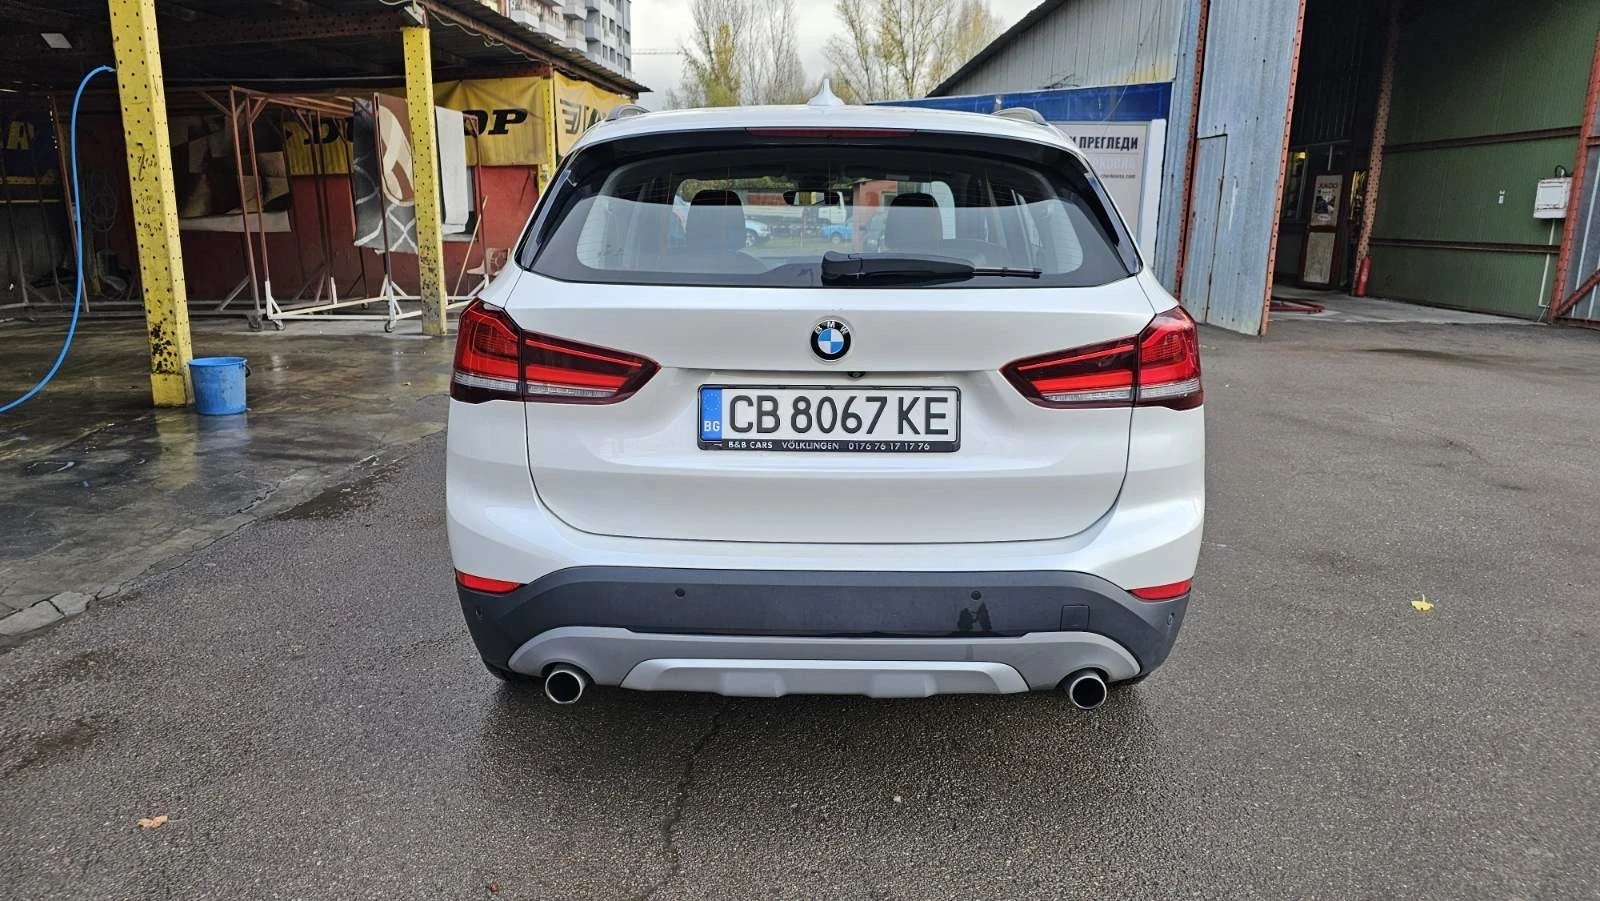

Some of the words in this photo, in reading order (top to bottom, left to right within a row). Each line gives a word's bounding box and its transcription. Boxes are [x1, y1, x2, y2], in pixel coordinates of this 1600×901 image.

[1079, 136, 1139, 151] ПРЕГЛЕДИ
[814, 320, 849, 335] BMW
[728, 394, 781, 434] CB
[790, 395, 888, 435] 8067
[897, 396, 949, 435] KE
[703, 420, 721, 433] BG
[728, 441, 747, 449] B&B
[749, 441, 773, 449] CARS
[782, 440, 839, 450] VÖLKLINGEN
[848, 442, 871, 450] 0176
[874, 442, 886, 450] 76
[889, 442, 900, 450] 17
[904, 442, 914, 450] 17
[918, 442, 930, 450] 76
